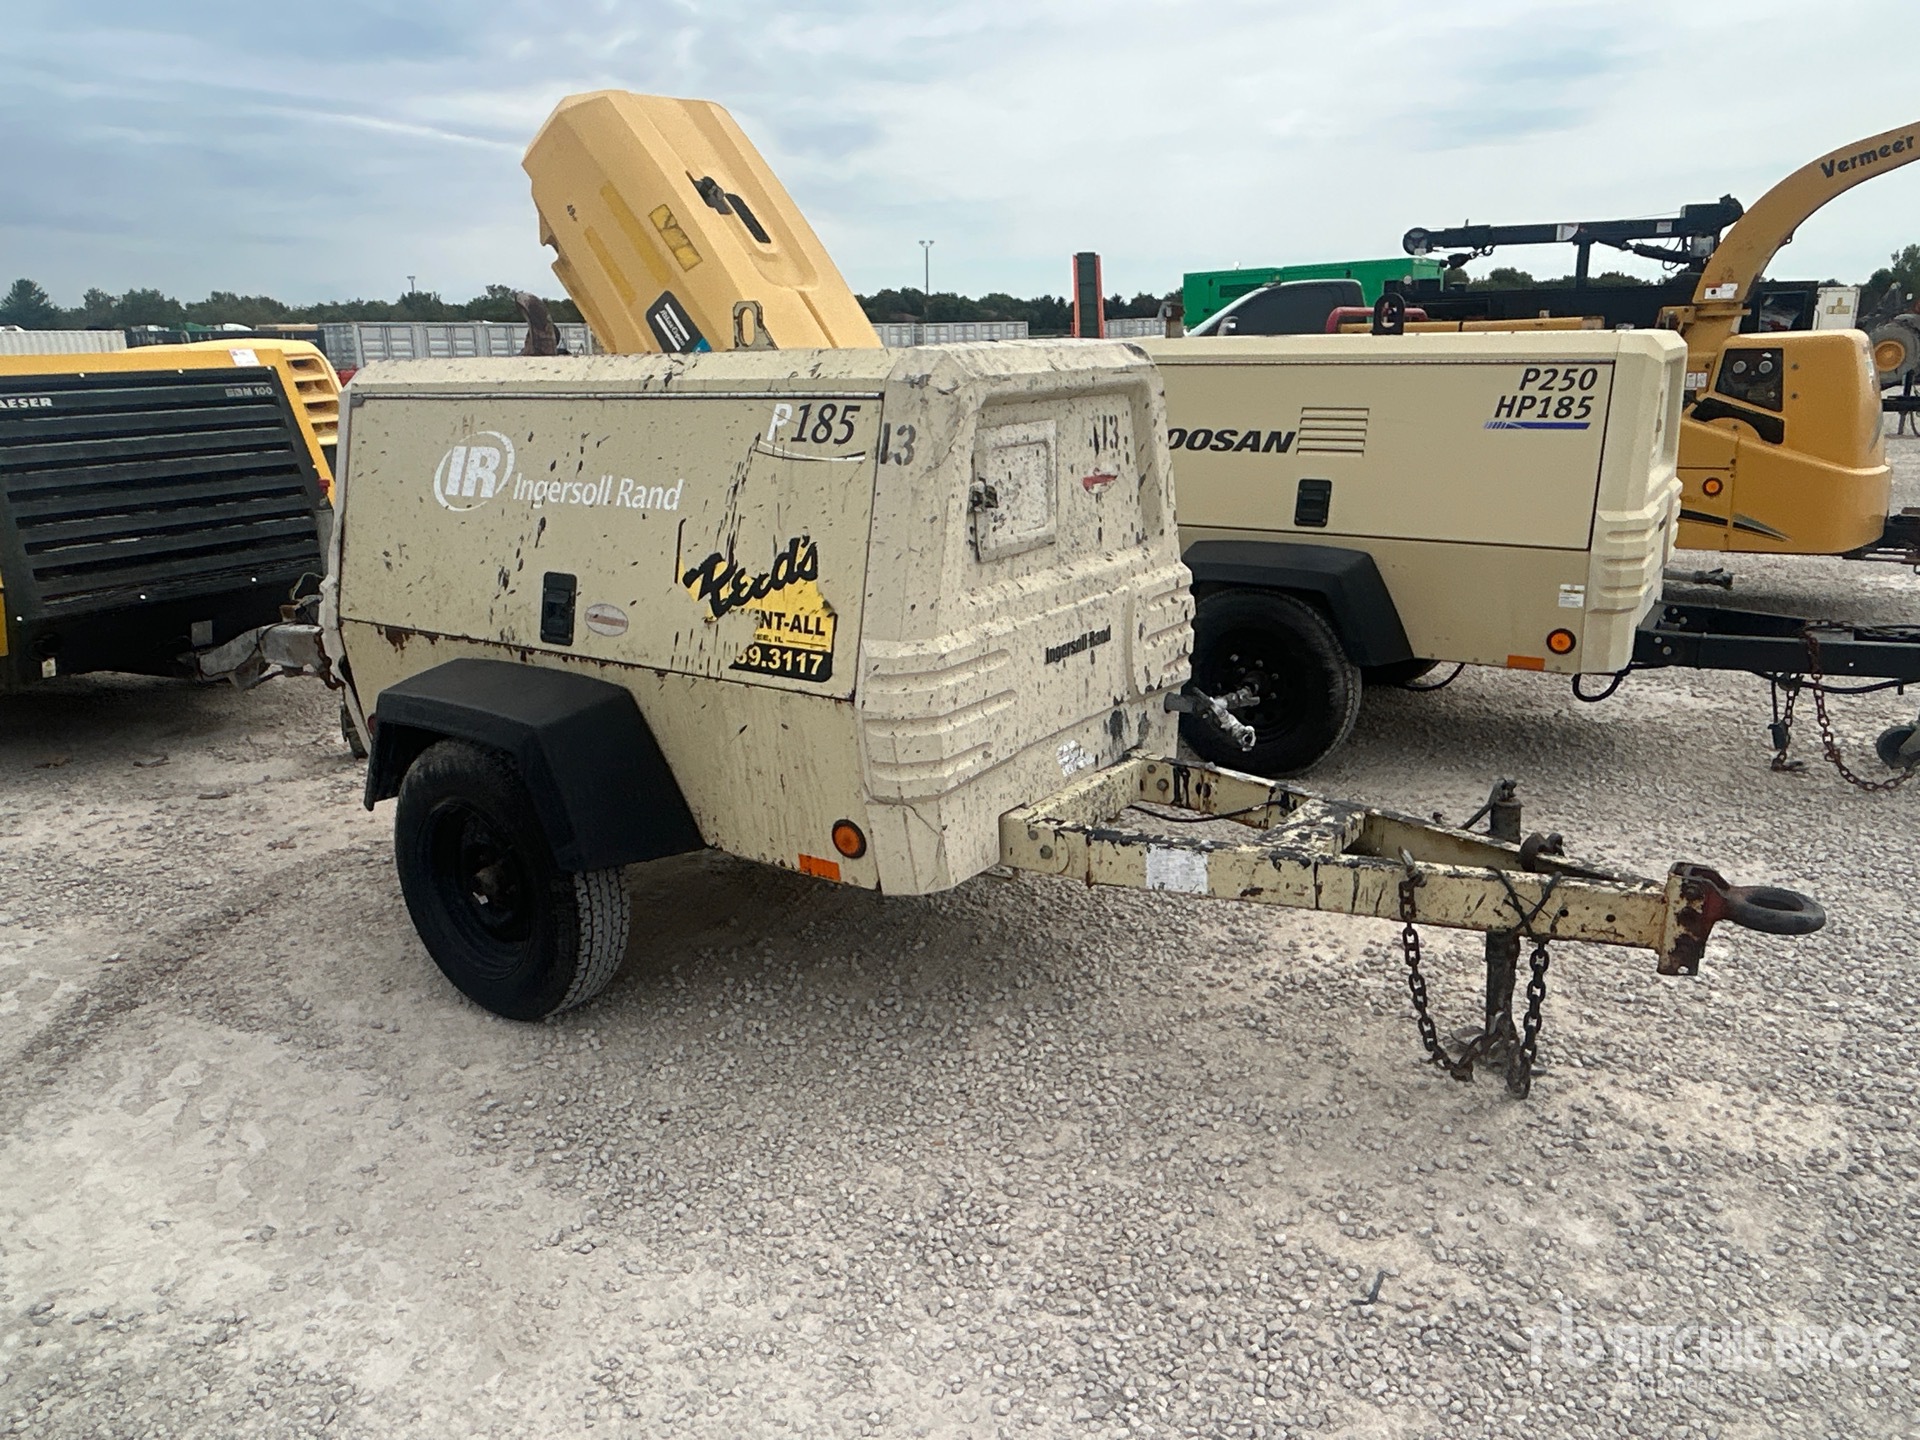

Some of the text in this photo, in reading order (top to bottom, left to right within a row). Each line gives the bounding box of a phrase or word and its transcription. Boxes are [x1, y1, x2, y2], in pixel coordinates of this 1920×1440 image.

[1820, 136, 1914, 178] Vermeer
[1519, 367, 1598, 391] P250
[0, 397, 53, 408] AESER
[1494, 395, 1595, 419] HP185
[880, 422, 916, 466] 13
[1168, 428, 1296, 453] OOSAN
[445, 446, 500, 498] IR
[513, 472, 684, 510] Ingersoll Rand
[755, 609, 826, 636] NT-ALL
